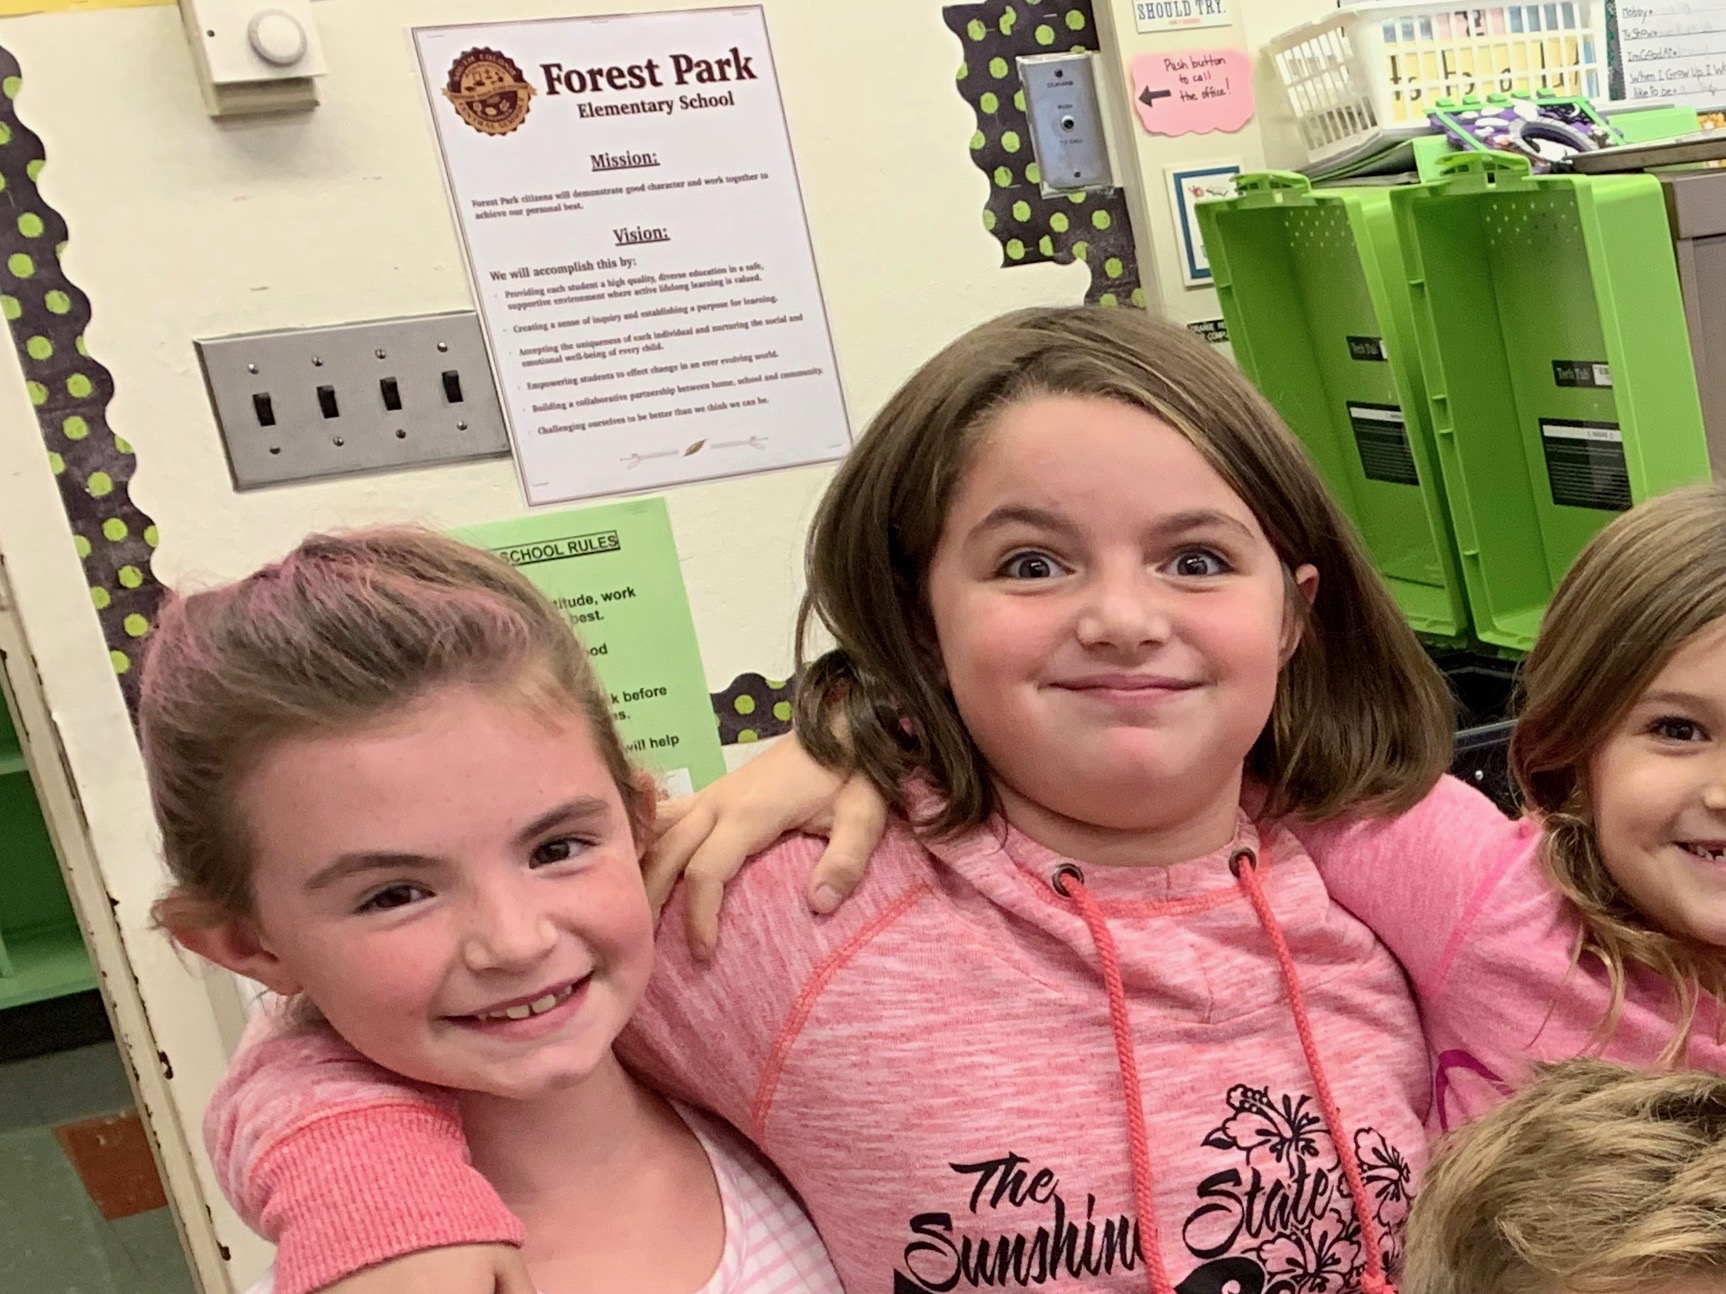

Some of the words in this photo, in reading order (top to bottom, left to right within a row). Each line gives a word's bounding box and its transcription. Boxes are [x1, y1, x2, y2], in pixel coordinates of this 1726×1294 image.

[1137, 0, 1191, 20] SHOULD
[1196, 0, 1227, 16] TRY.
[539, 58, 663, 95] Forest
[668, 46, 757, 85] Park
[1164, 57, 1188, 72] Push
[1189, 54, 1226, 69] button
[1179, 74, 1189, 85] to
[1193, 70, 1212, 82] call
[576, 99, 673, 118] Elementary
[678, 90, 734, 110] School
[1180, 90, 1198, 102] the
[589, 150, 660, 172] Mission:
[612, 225, 671, 246] Vision:
[488, 270, 507, 281] We
[508, 266, 530, 278] will
[532, 260, 594, 276] accomplish
[596, 257, 617, 269] this
[618, 256, 636, 269] by:
[501, 544, 564, 565] SCHOOL
[568, 534, 619, 554] RULES
[553, 594, 598, 610] titude,
[601, 586, 636, 603] work
[622, 685, 667, 703] before
[649, 734, 679, 750] help
[949, 1151, 1060, 1213] The
[1182, 1166, 1335, 1259] State
